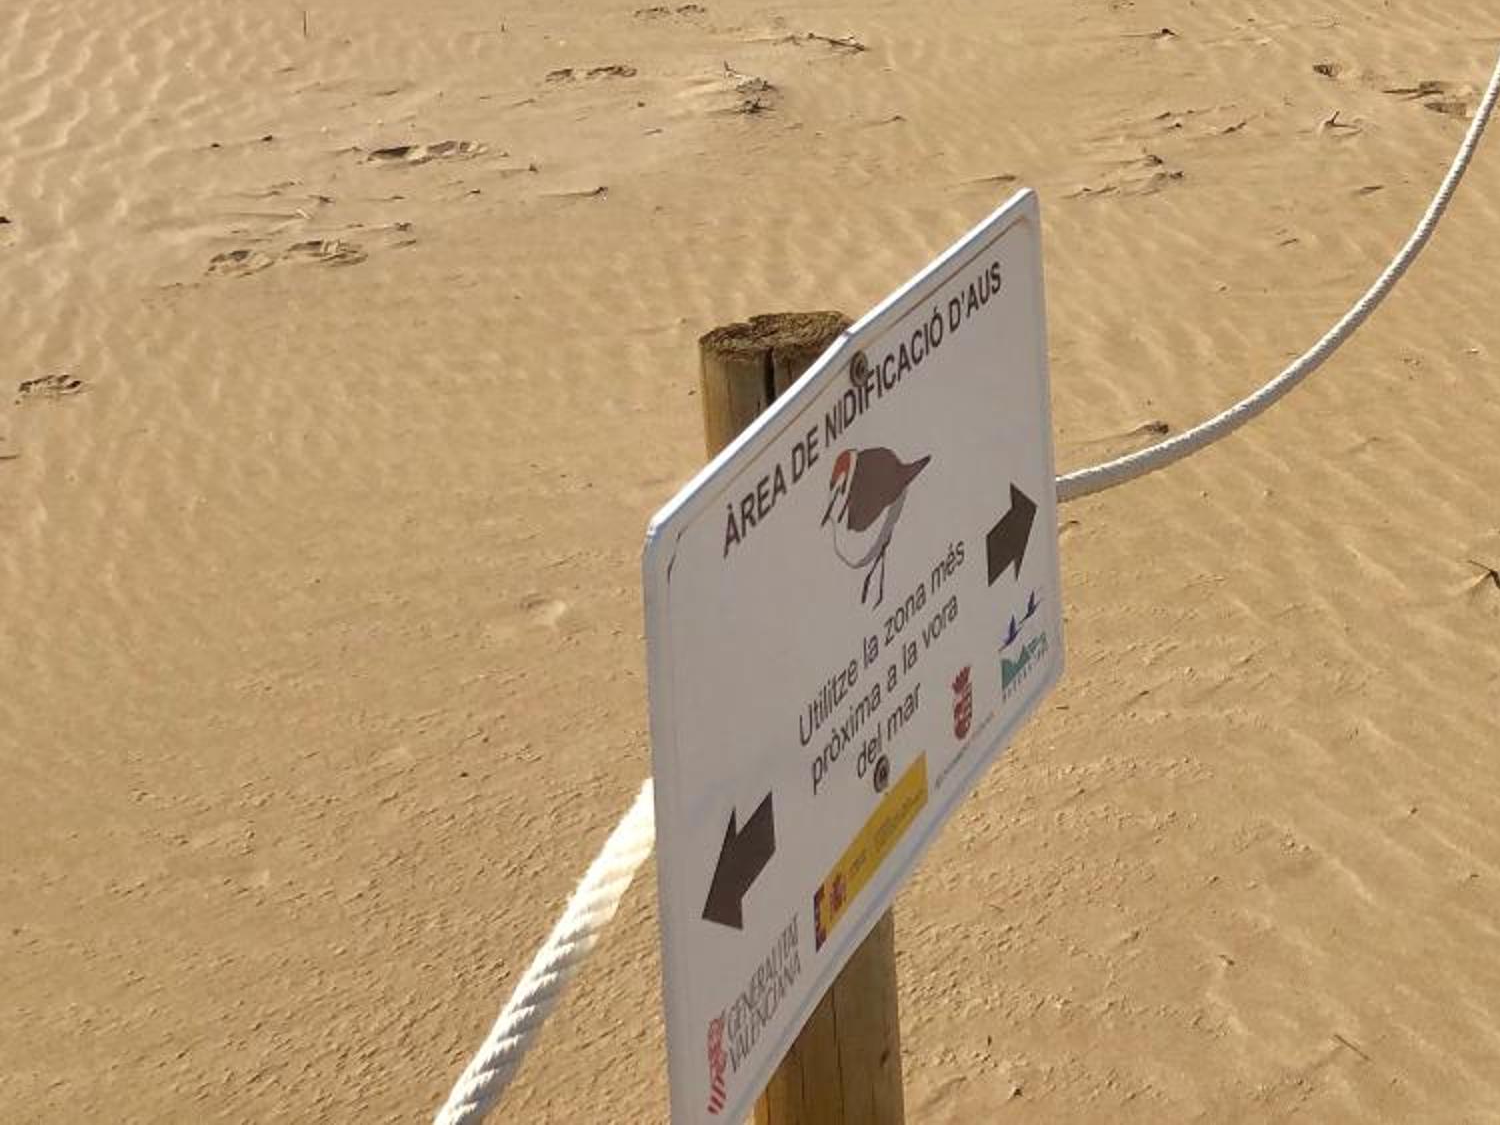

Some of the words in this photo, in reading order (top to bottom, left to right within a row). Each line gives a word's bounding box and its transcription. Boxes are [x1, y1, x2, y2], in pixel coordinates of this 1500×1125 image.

[723, 463, 787, 559] ÀREA
[791, 424, 819, 485] DE
[824, 305, 944, 449] NIDIFICACIÓ
[949, 261, 1002, 335] D'AUS
[799, 659, 858, 747] Utilitze
[862, 634, 879, 670] la
[883, 582, 926, 647] zona
[930, 540, 965, 595] més
[811, 683, 881, 795] pròxima
[887, 664, 897, 693] a
[902, 641, 918, 674] la
[922, 594, 958, 649] vora
[856, 723, 883, 779] del
[887, 682, 921, 742] mar
